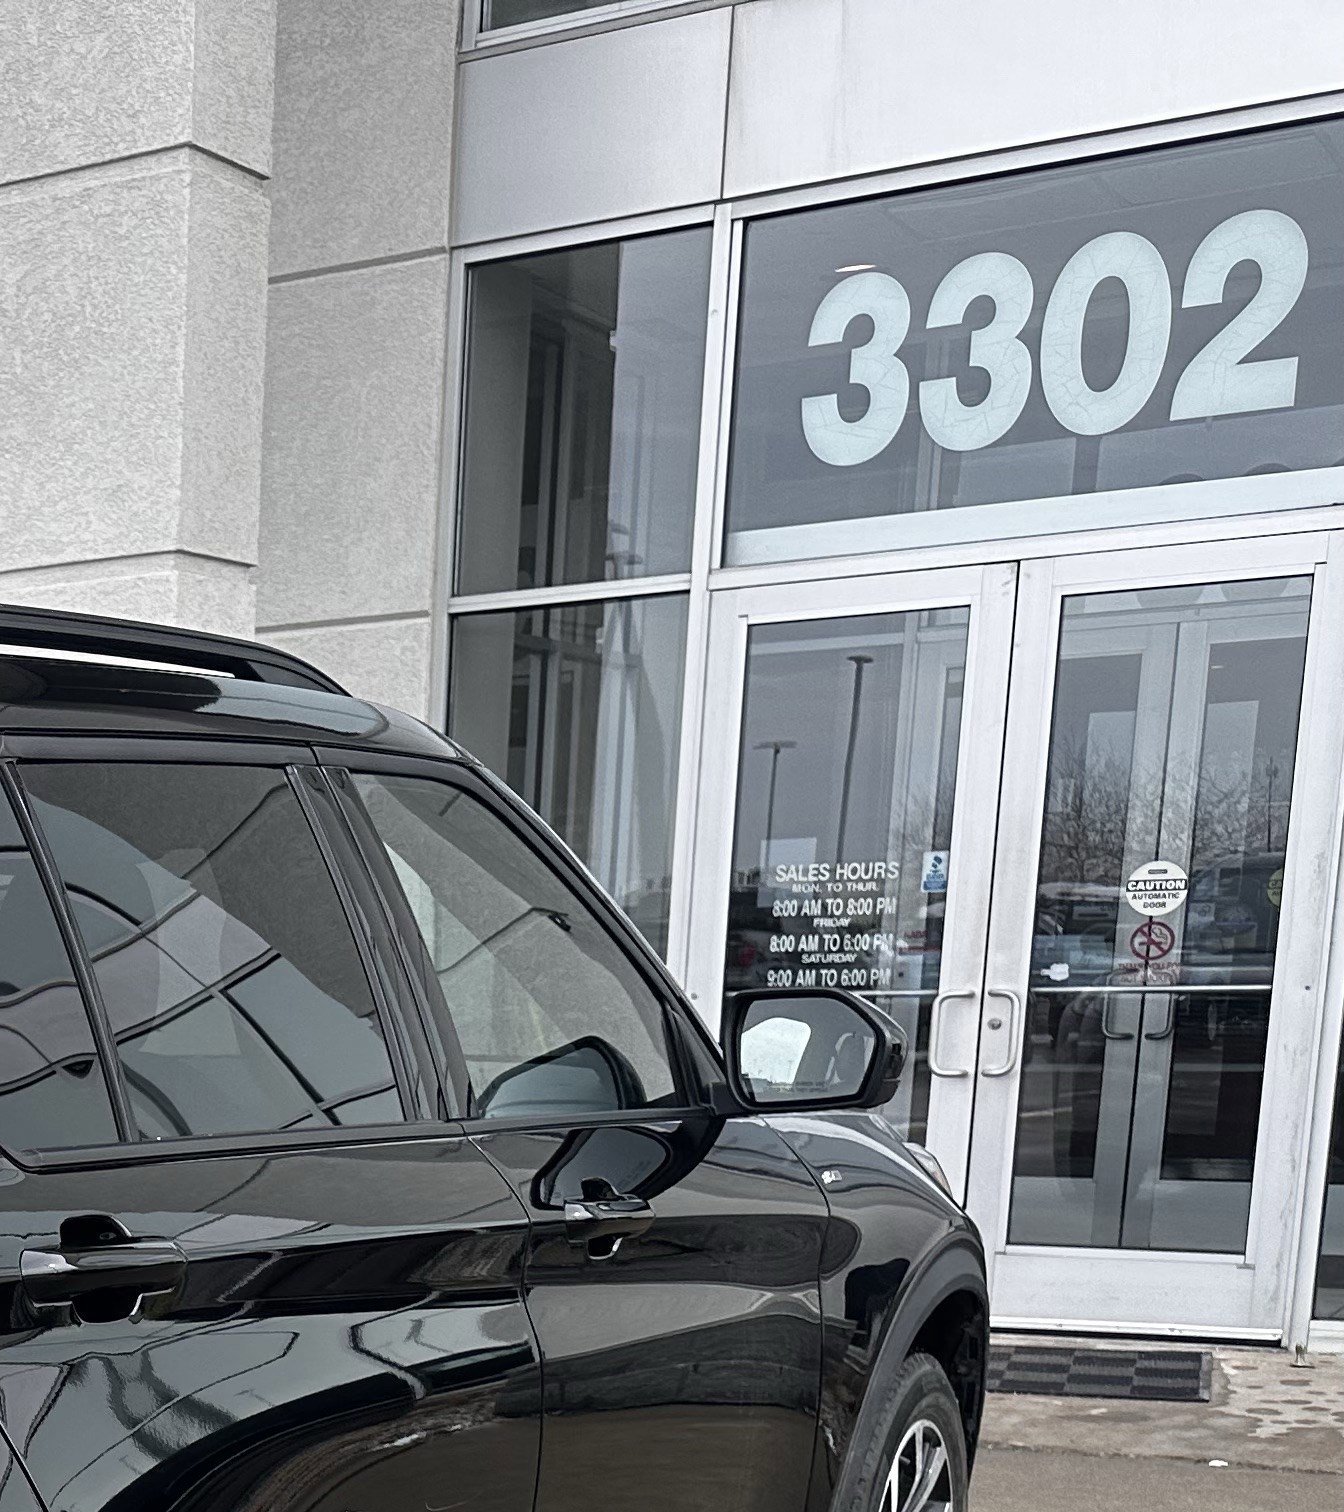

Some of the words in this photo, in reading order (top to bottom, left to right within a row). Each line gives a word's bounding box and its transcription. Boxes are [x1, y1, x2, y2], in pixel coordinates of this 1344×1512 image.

[801, 208, 1309, 467] 3302
[775, 862, 830, 882] SALES
[835, 861, 900, 881] HOURS
[792, 882, 821, 893] MON.
[827, 882, 842, 892] TO
[1127, 879, 1186, 891] CAUTION
[1131, 892, 1180, 901] AUTOMATIC
[772, 899, 798, 917] 8:00
[801, 899, 821, 916] AM
[826, 898, 843, 915] TO
[846, 898, 873, 915] 8:00
[876, 897, 897, 915] PM
[1142, 901, 1167, 909] DOOR
[813, 917, 851, 928] FRIDAY
[769, 934, 795, 952] 8:00
[798, 934, 819, 951] AM
[823, 934, 841, 951] TO
[843, 934, 870, 951] 6:00
[873, 933, 894, 951] PM
[801, 953, 857, 964] SATURDAY
[766, 969, 793, 987] 9:00
[795, 969, 816, 987] AM
[820, 969, 838, 986] TO
[840, 968, 867, 986] 6:00
[870, 968, 891, 986] PM
